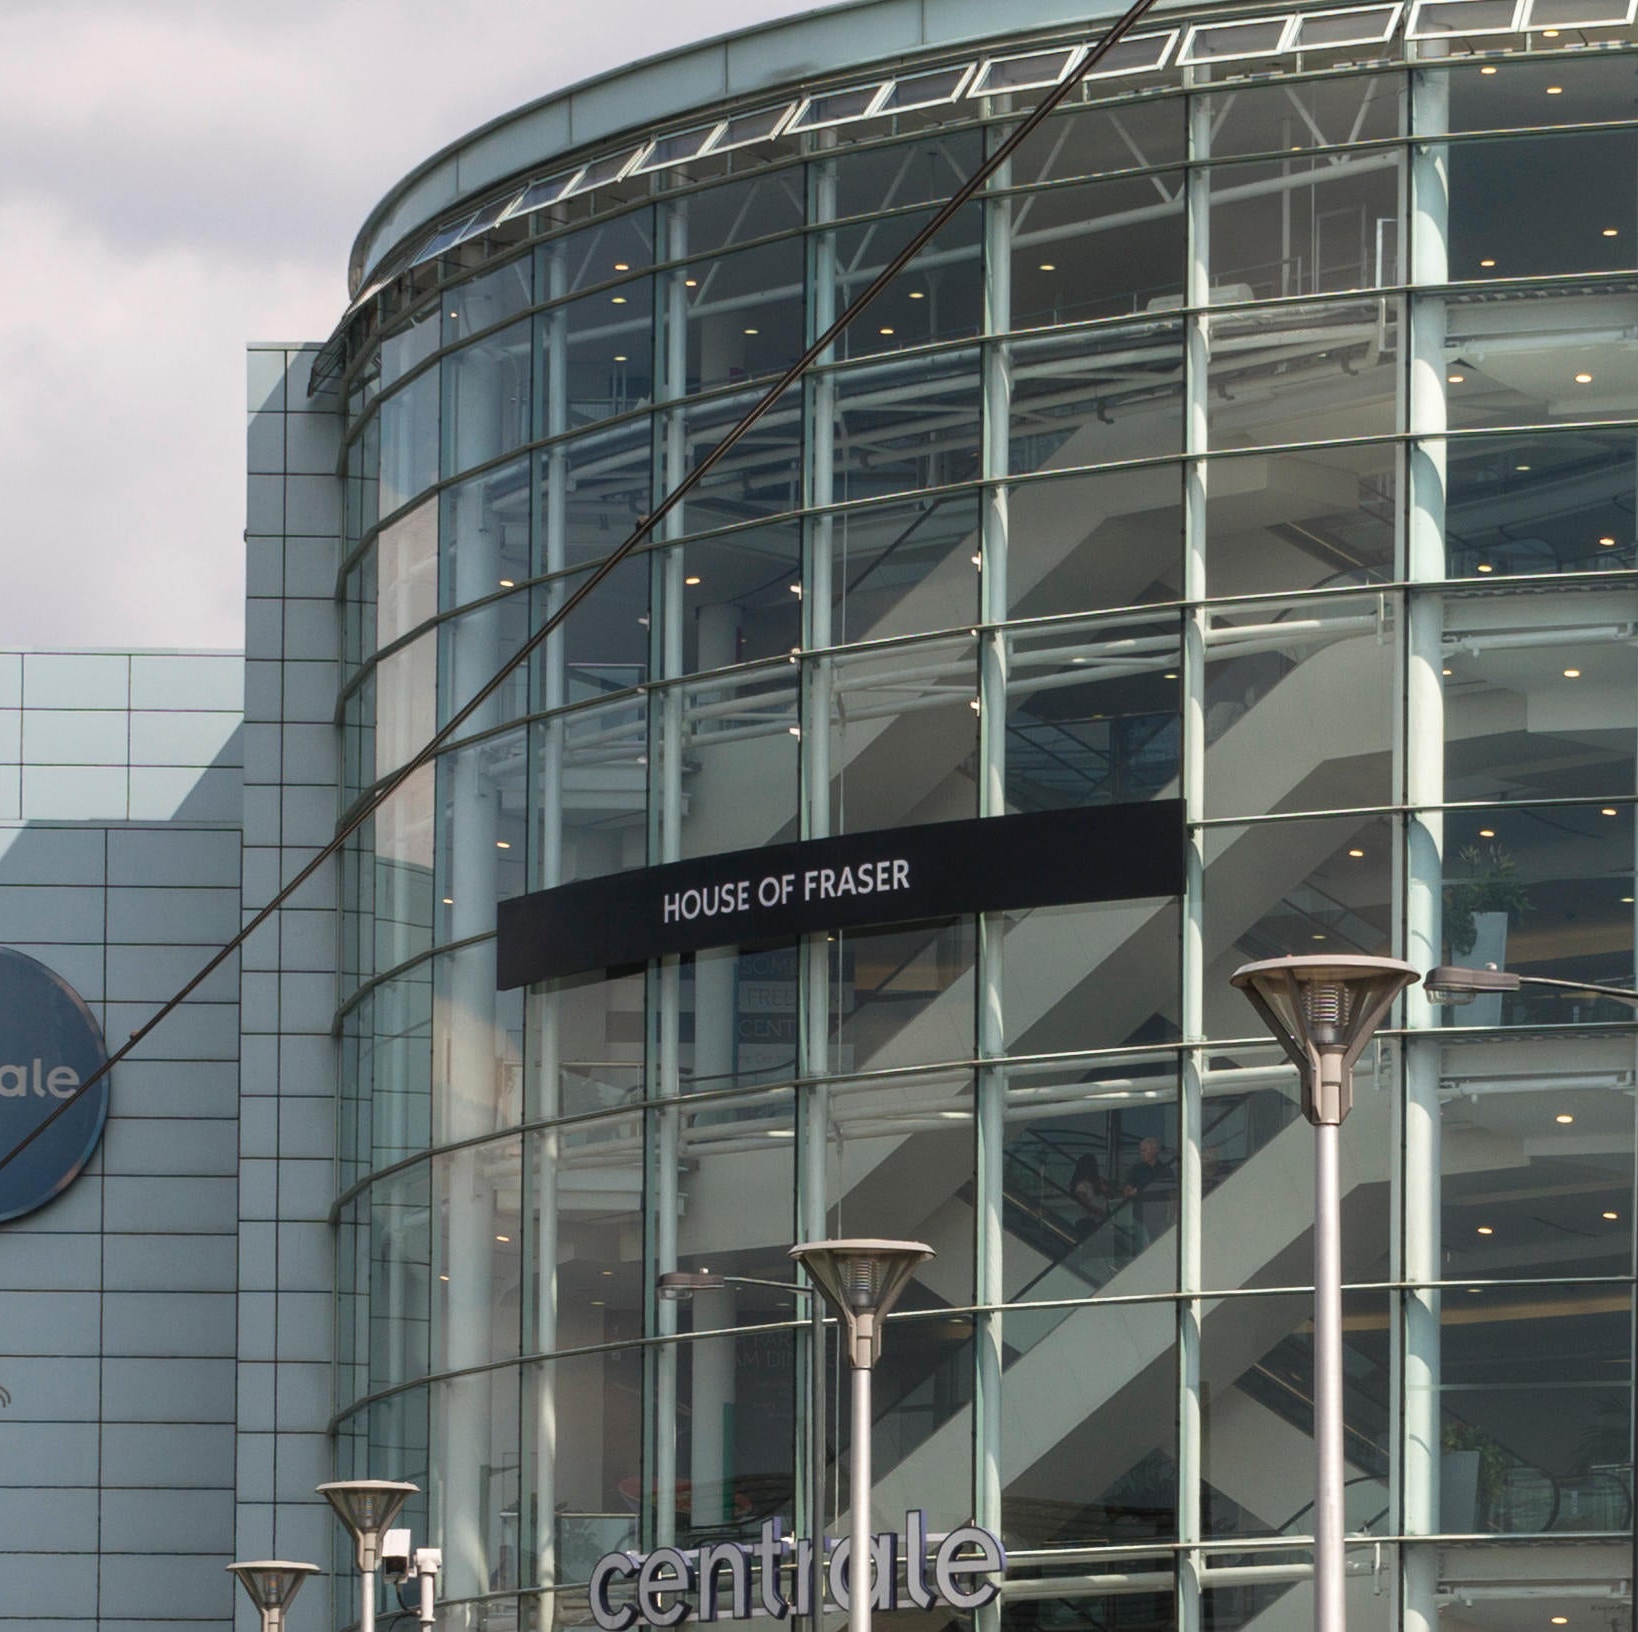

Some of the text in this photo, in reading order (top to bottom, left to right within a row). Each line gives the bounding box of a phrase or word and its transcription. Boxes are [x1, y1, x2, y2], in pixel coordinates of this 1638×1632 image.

[664, 859, 911, 923] HOUSE OF FRASER
[588, 1509, 1006, 1631] centrale
